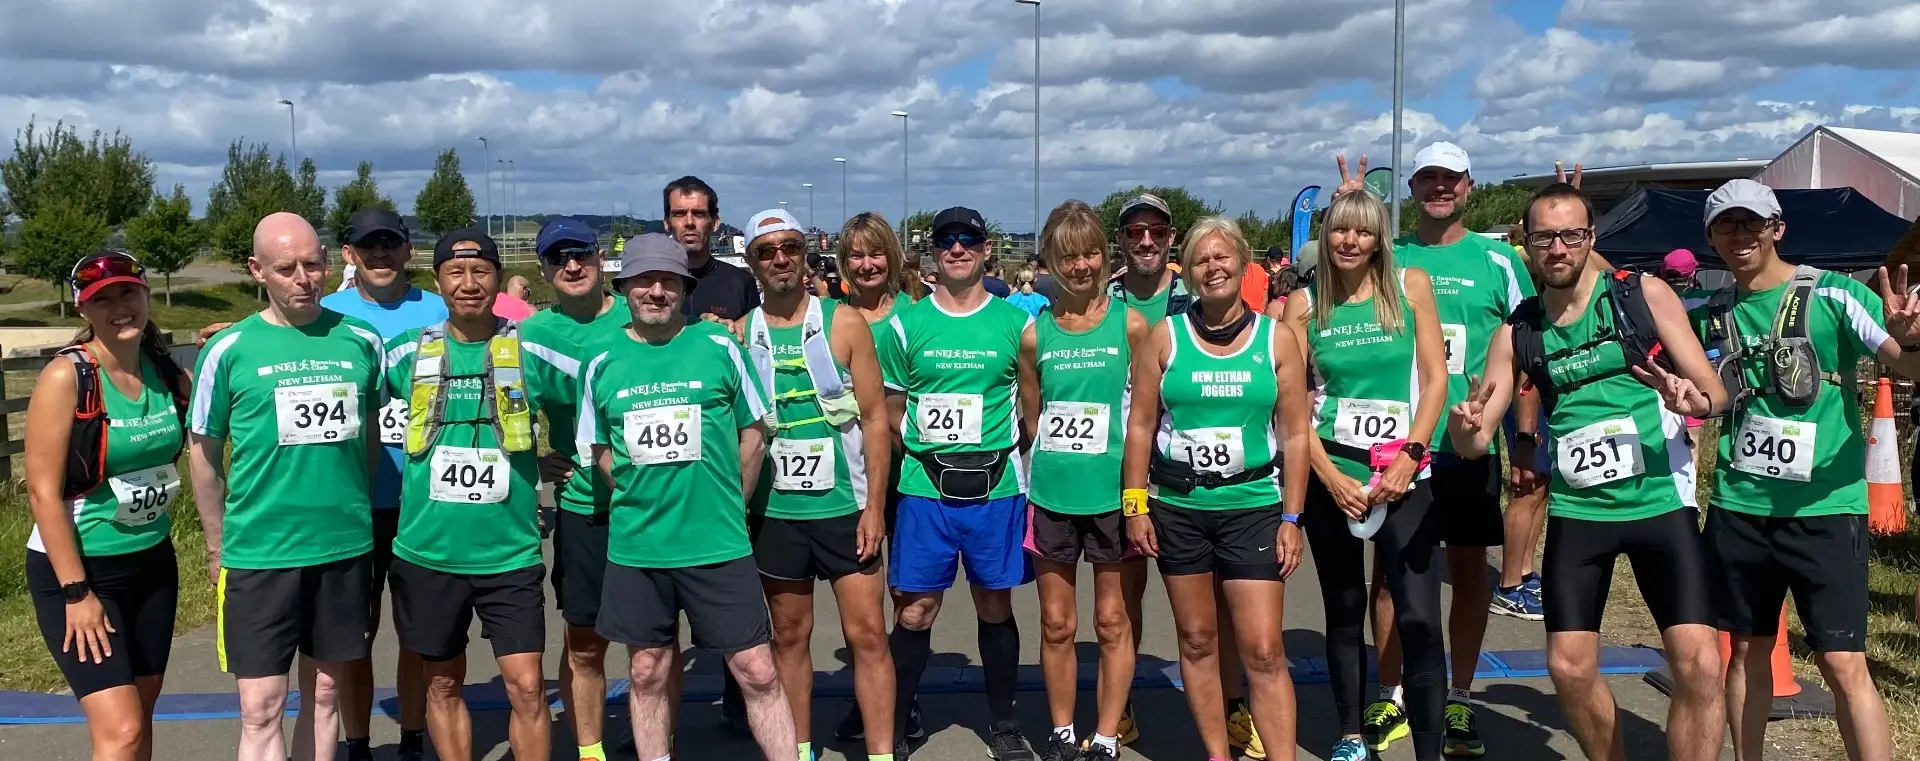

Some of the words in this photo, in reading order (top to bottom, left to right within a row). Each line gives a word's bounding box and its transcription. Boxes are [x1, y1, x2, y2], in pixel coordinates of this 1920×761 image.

[1333, 325, 1352, 336] NEJ
[1335, 340, 1355, 349] NEW
[1356, 335, 1393, 346] ELTHAM
[935, 349, 953, 359] NEJ
[1052, 350, 1071, 359] NEJ
[273, 361, 298, 373] NEJ
[309, 359, 340, 367] Running
[935, 362, 952, 370] NEW
[953, 362, 985, 370] ELTHAM
[1053, 363, 1072, 371] NEW
[1072, 361, 1106, 369] ELTHAM
[278, 378, 301, 387] NEW
[301, 374, 343, 384] ELTHAM
[1191, 371, 1214, 383] NEW
[1215, 371, 1252, 383] ELTHAM
[630, 385, 649, 396] NEJ
[661, 385, 677, 393] Club
[1201, 384, 1244, 397] JOGGERS
[632, 401, 652, 410] NEW
[653, 397, 689, 406] ELTHAM
[294, 399, 347, 429] 394
[927, 408, 964, 430] 261
[1049, 416, 1094, 439] 262
[1353, 415, 1397, 440] 102
[130, 433, 148, 442] NEW
[637, 422, 689, 449] 486
[1742, 432, 1796, 464] 340
[1184, 443, 1231, 468] 138
[1570, 437, 1621, 474] 251
[780, 455, 821, 477] 127
[440, 463, 495, 489] 404
[129, 484, 168, 514] 506
